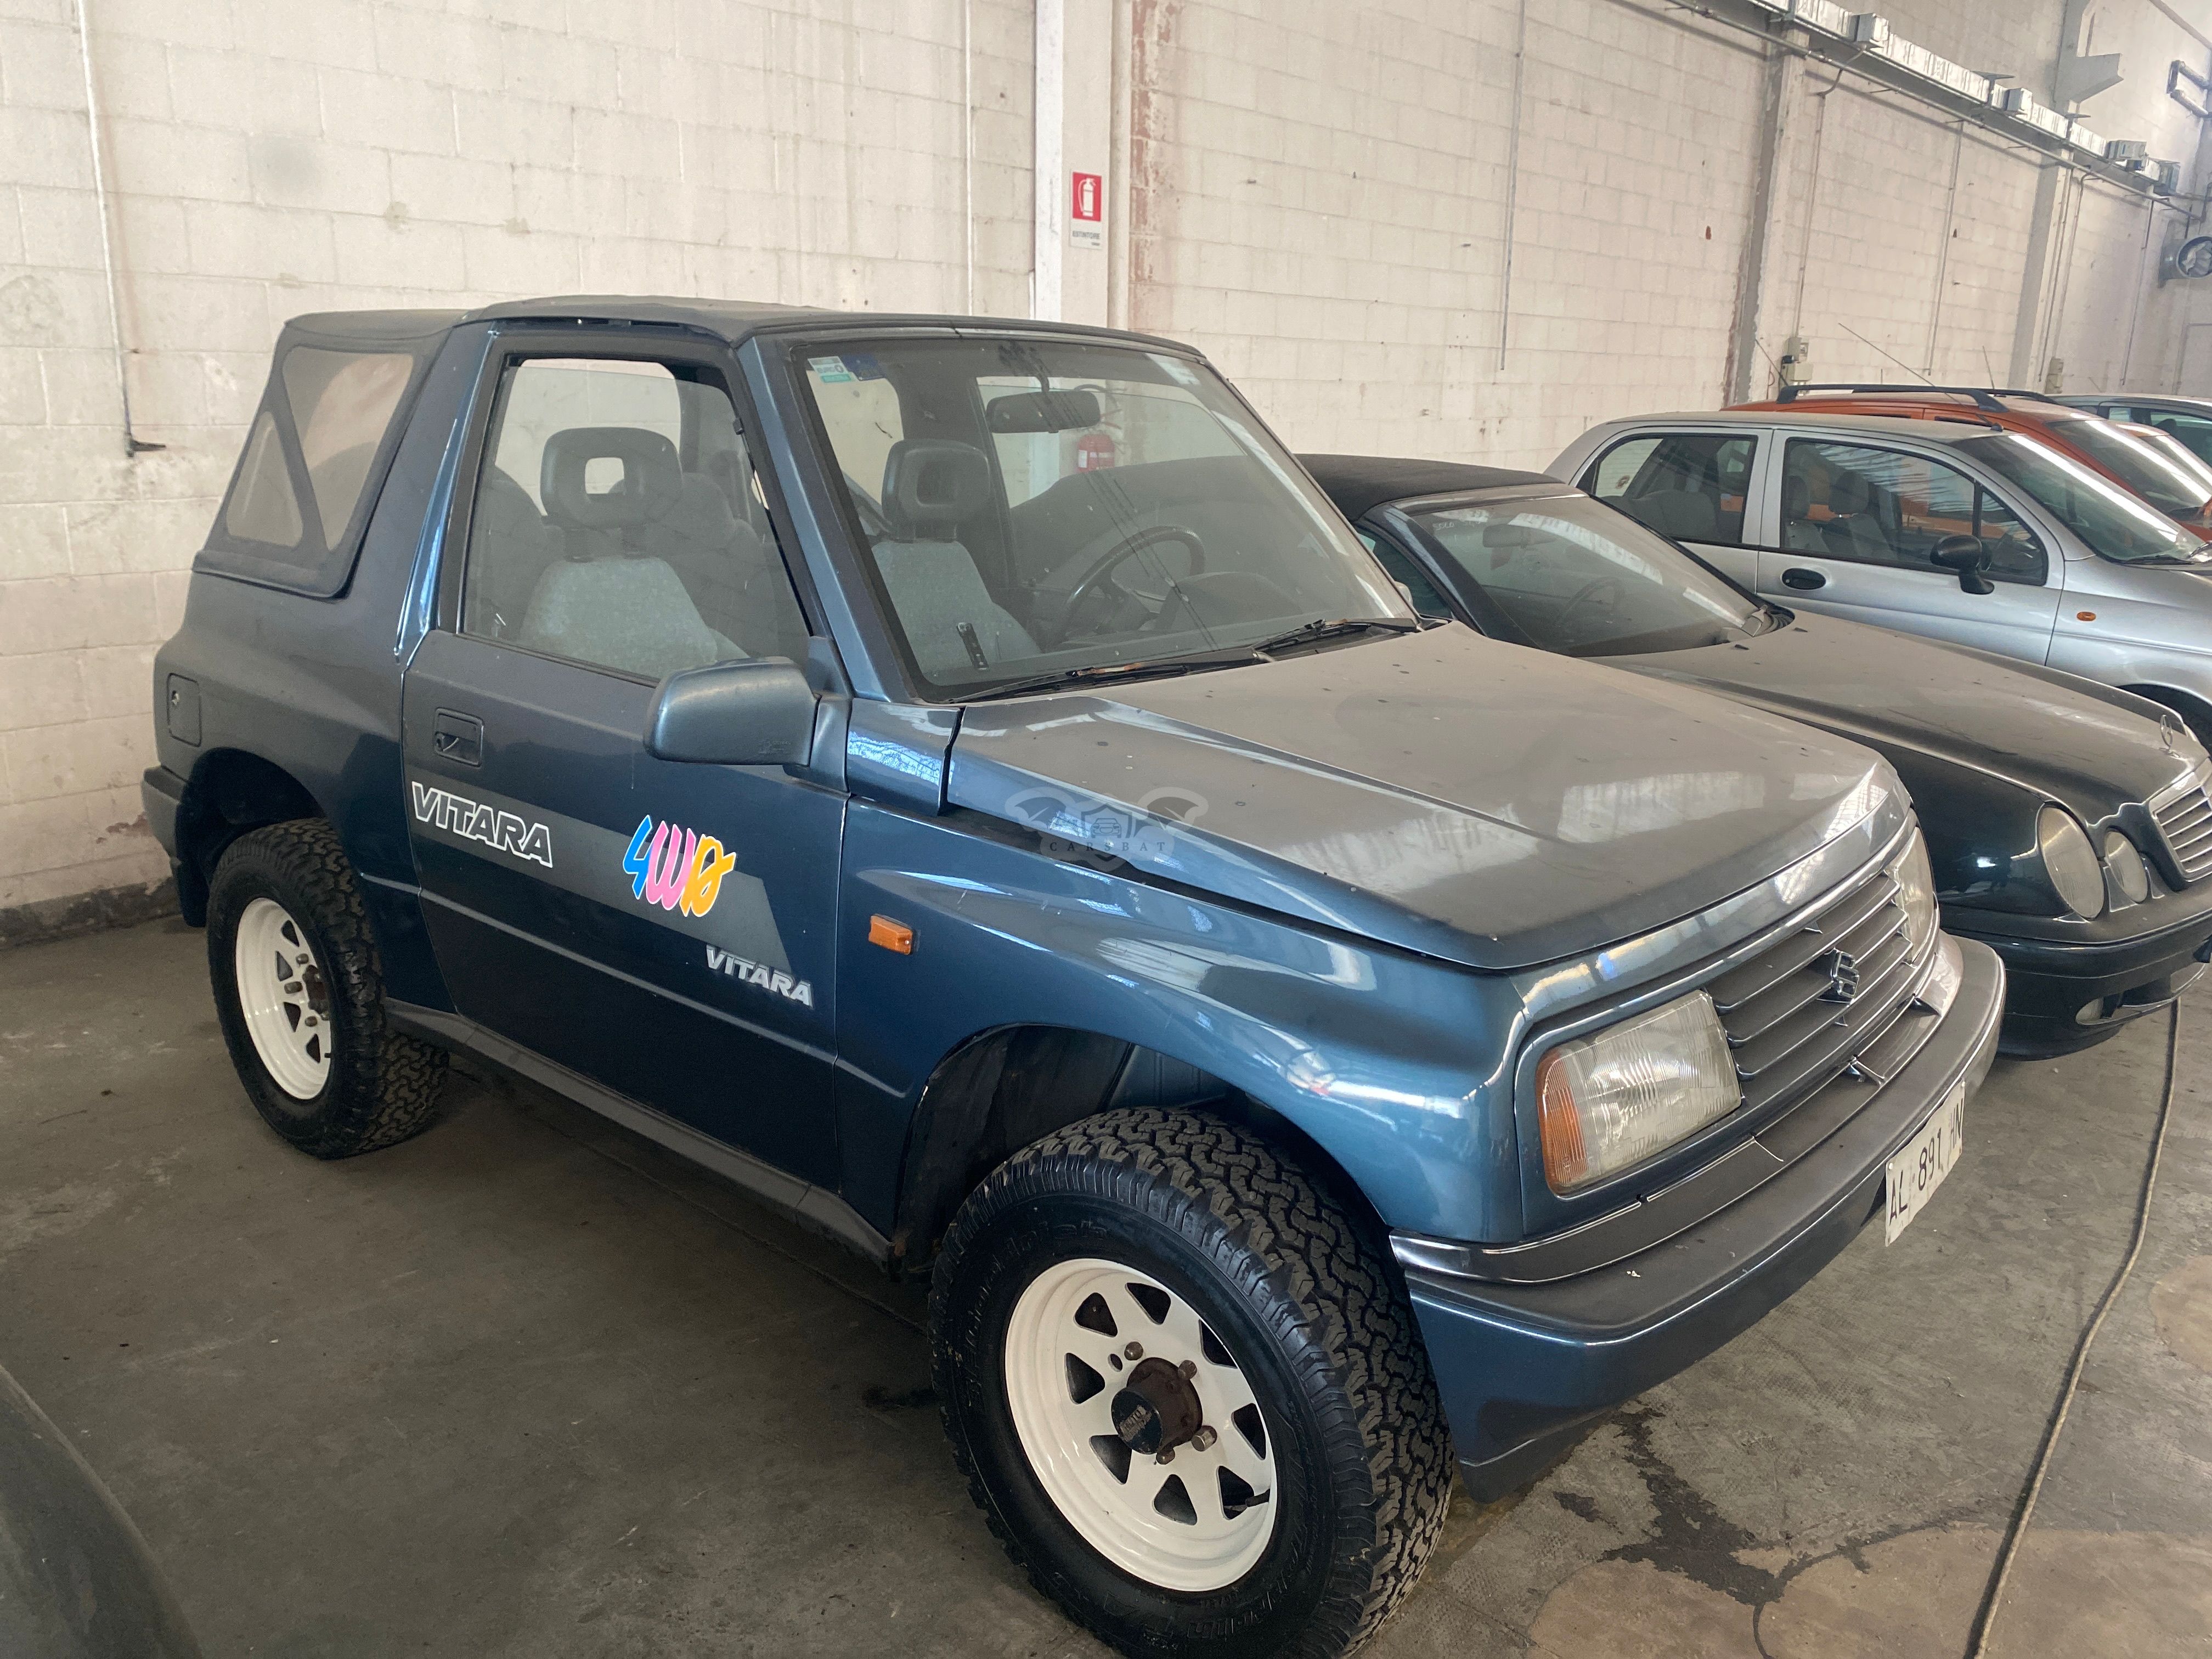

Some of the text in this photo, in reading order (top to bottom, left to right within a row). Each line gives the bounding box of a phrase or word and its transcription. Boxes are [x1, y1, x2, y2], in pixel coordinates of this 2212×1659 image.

[411, 781, 553, 868] VITARA
[622, 814, 737, 917] 4WD
[706, 945, 814, 1008] VITARA
